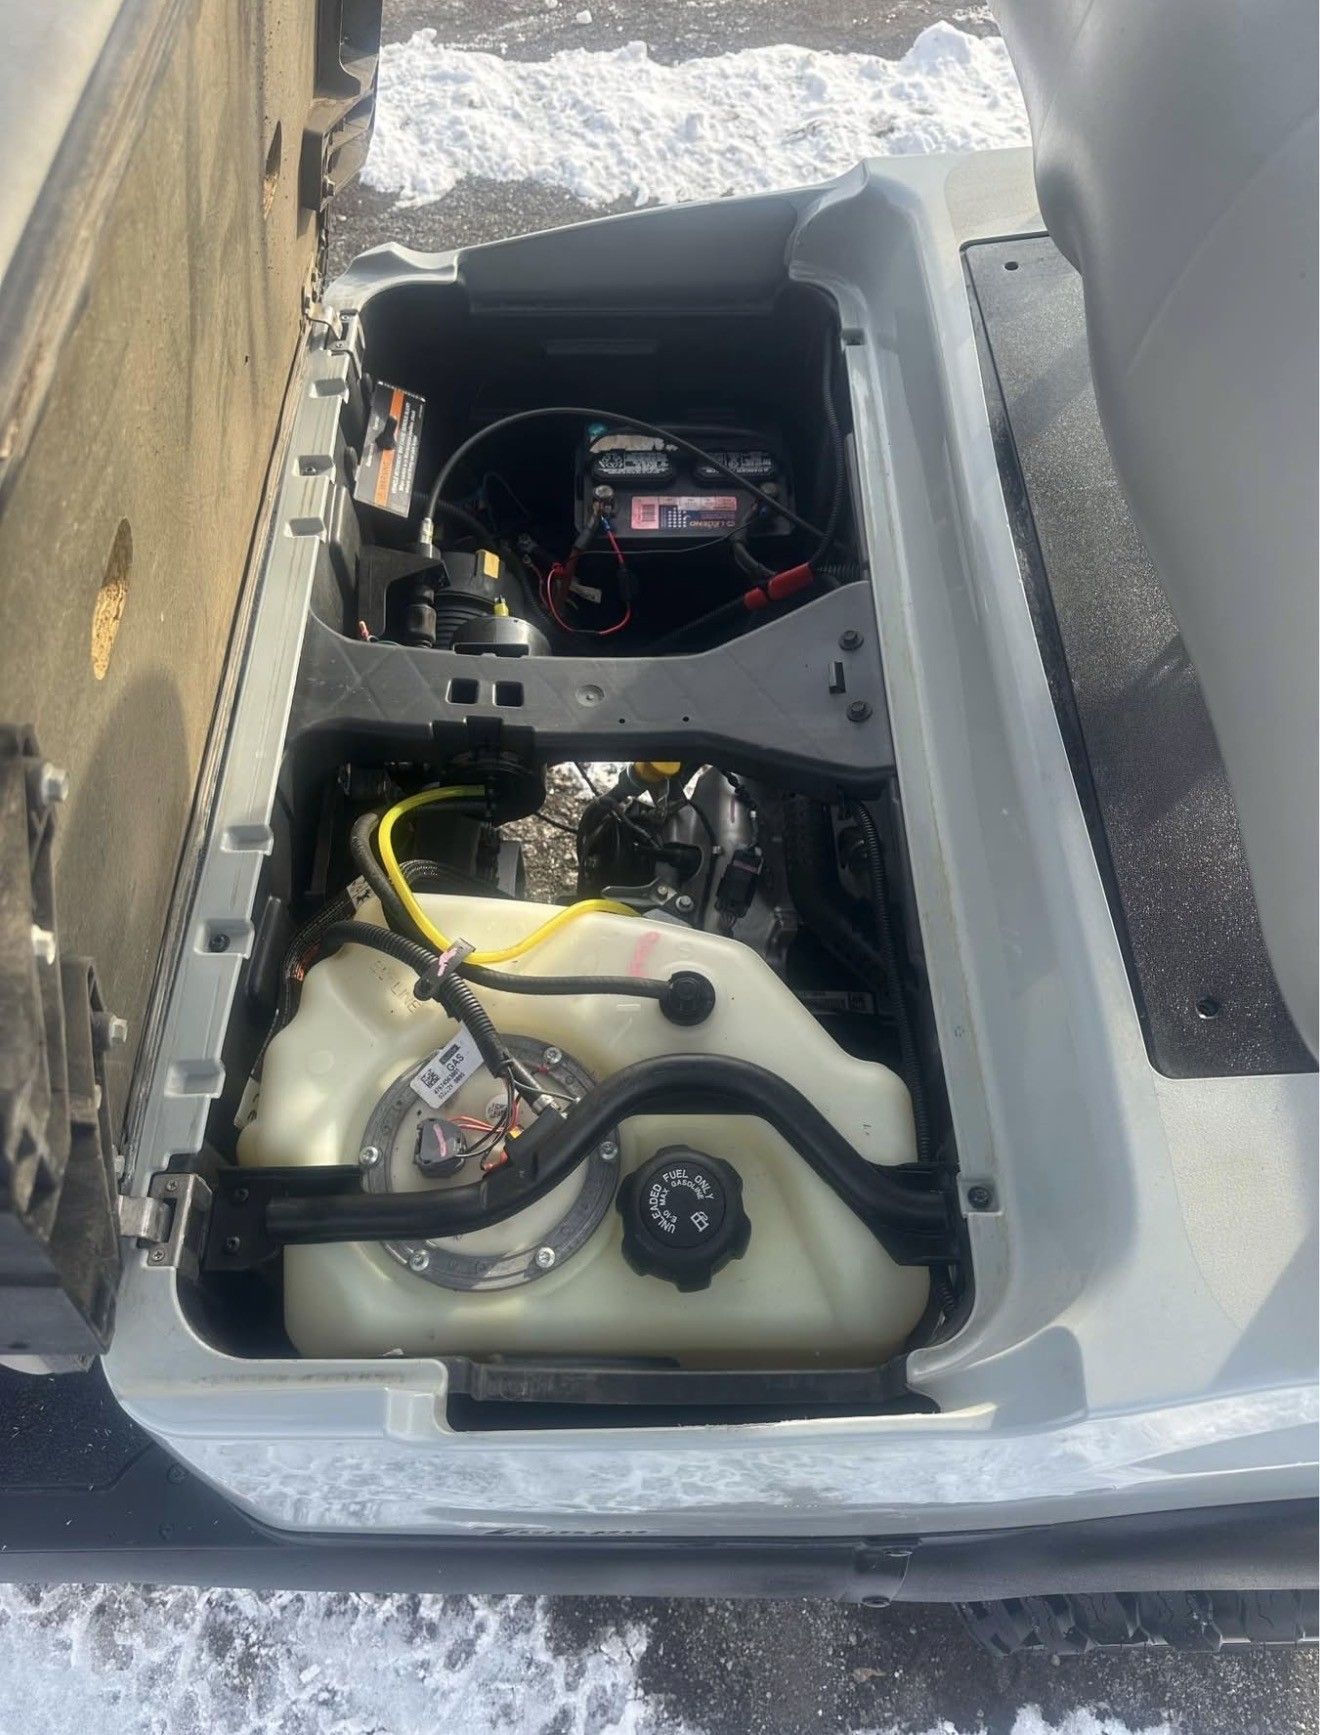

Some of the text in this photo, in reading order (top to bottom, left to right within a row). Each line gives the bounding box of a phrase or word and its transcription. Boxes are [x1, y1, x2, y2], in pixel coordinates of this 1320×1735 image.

[446, 1053, 464, 1071] GAS
[649, 1169, 715, 1233] UNLEADED FUEL ONLY
[659, 1187, 669, 1206] MAX
[670, 1179, 705, 1200] GASOLINE
